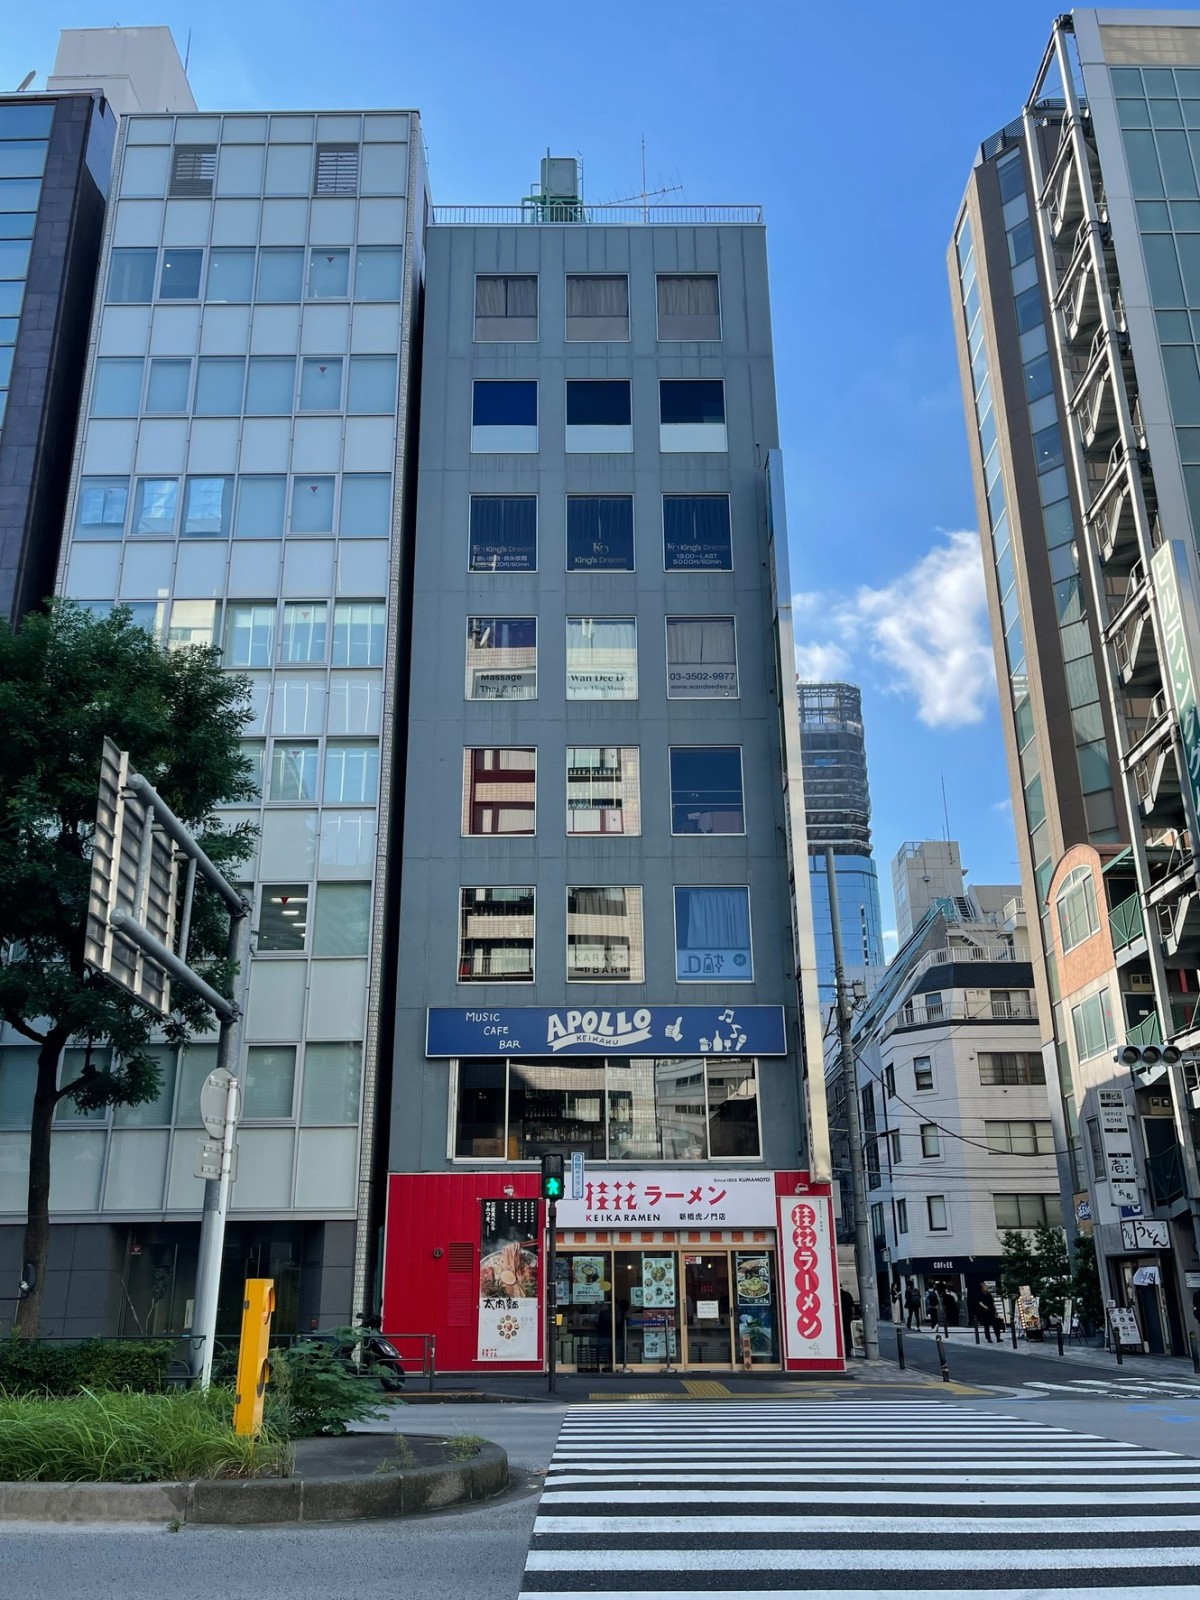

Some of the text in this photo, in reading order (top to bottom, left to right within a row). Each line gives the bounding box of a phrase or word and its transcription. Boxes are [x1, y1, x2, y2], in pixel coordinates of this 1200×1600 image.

[680, 544, 702, 552] King's
[575, 557, 598, 565] King's
[480, 674, 522, 682] Massage
[571, 674, 592, 682] Wan
[670, 672, 735, 681] 03-3502-9977
[592, 966, 618, 974] BAR
[465, 1012, 500, 1022] MUSIC
[547, 1008, 652, 1042] APOLLO
[484, 1026, 509, 1036] CAFE
[576, 1034, 619, 1046] KEIKAKU
[499, 1040, 521, 1050] BAR
[586, 1214, 660, 1222] KEIKA RAMEN
[679, 1212, 726, 1221] 新橋虎ノ門店
[1136, 1222, 1168, 1248] うどん
[794, 1206, 818, 1336] 桂花ラーメン
